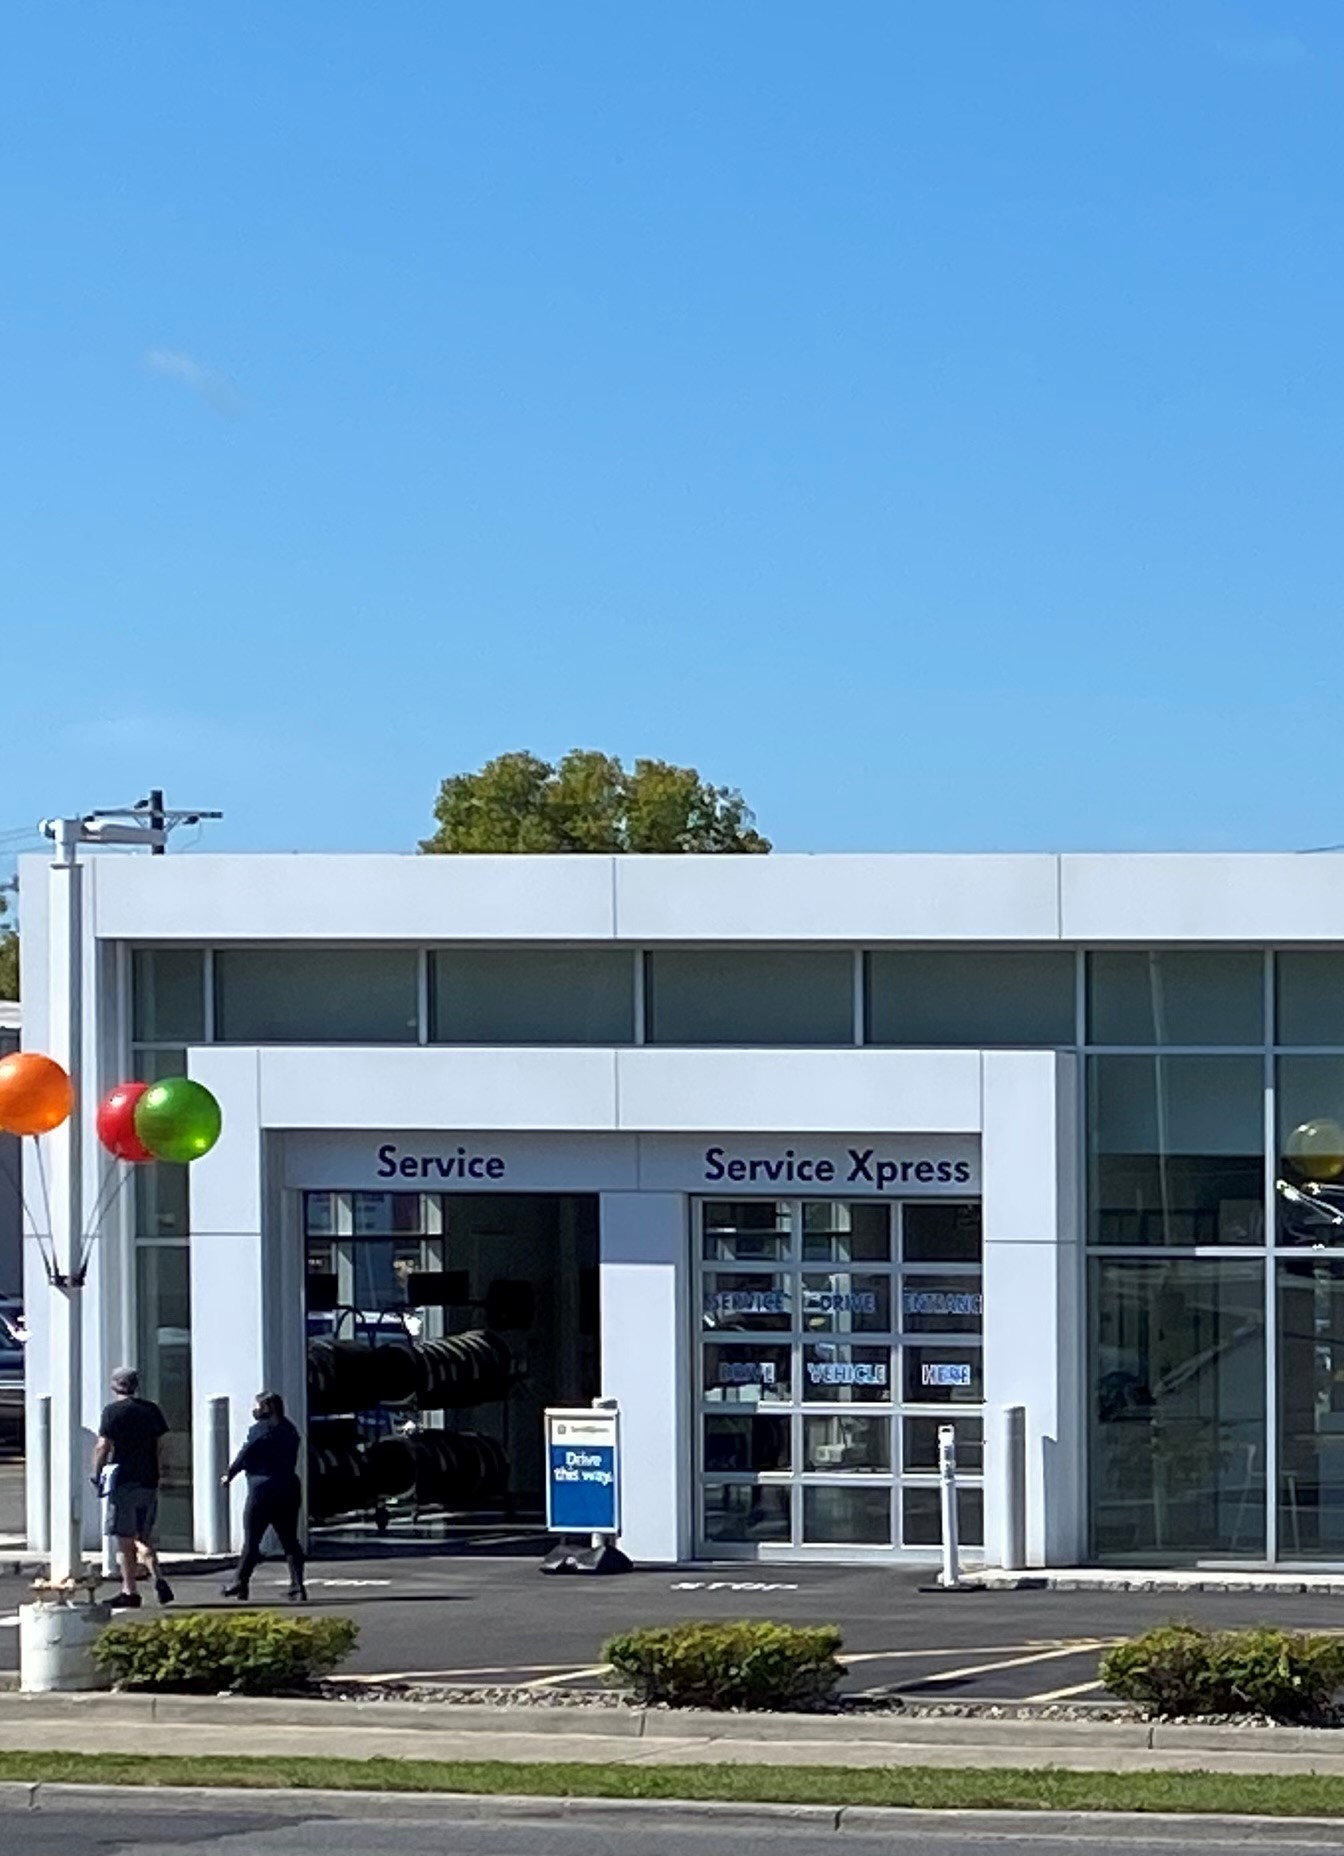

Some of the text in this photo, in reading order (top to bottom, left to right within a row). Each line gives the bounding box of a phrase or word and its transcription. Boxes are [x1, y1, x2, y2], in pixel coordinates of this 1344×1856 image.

[376, 1144, 506, 1179] Service
[704, 1147, 970, 1190] Service Xpress
[808, 1363, 886, 1384] VEHICLE
[565, 1451, 602, 1467] Drive
